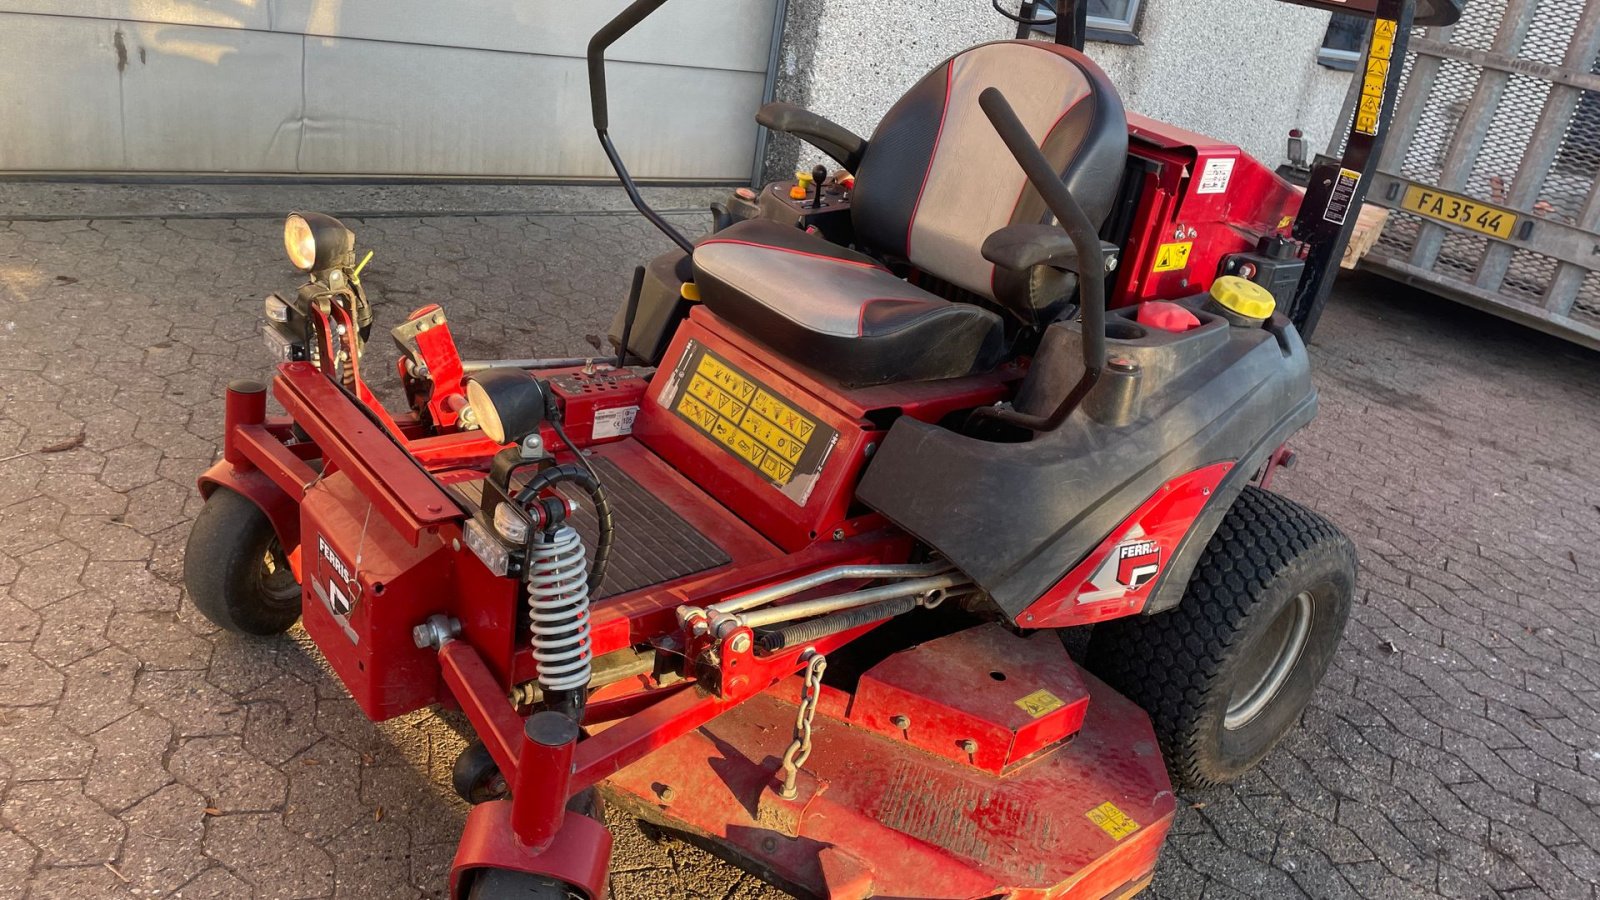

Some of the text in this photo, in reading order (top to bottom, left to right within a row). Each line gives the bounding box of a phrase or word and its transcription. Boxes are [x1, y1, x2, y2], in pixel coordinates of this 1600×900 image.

[1417, 192, 1502, 232] FA 35 44
[320, 537, 350, 583] FERRIS
